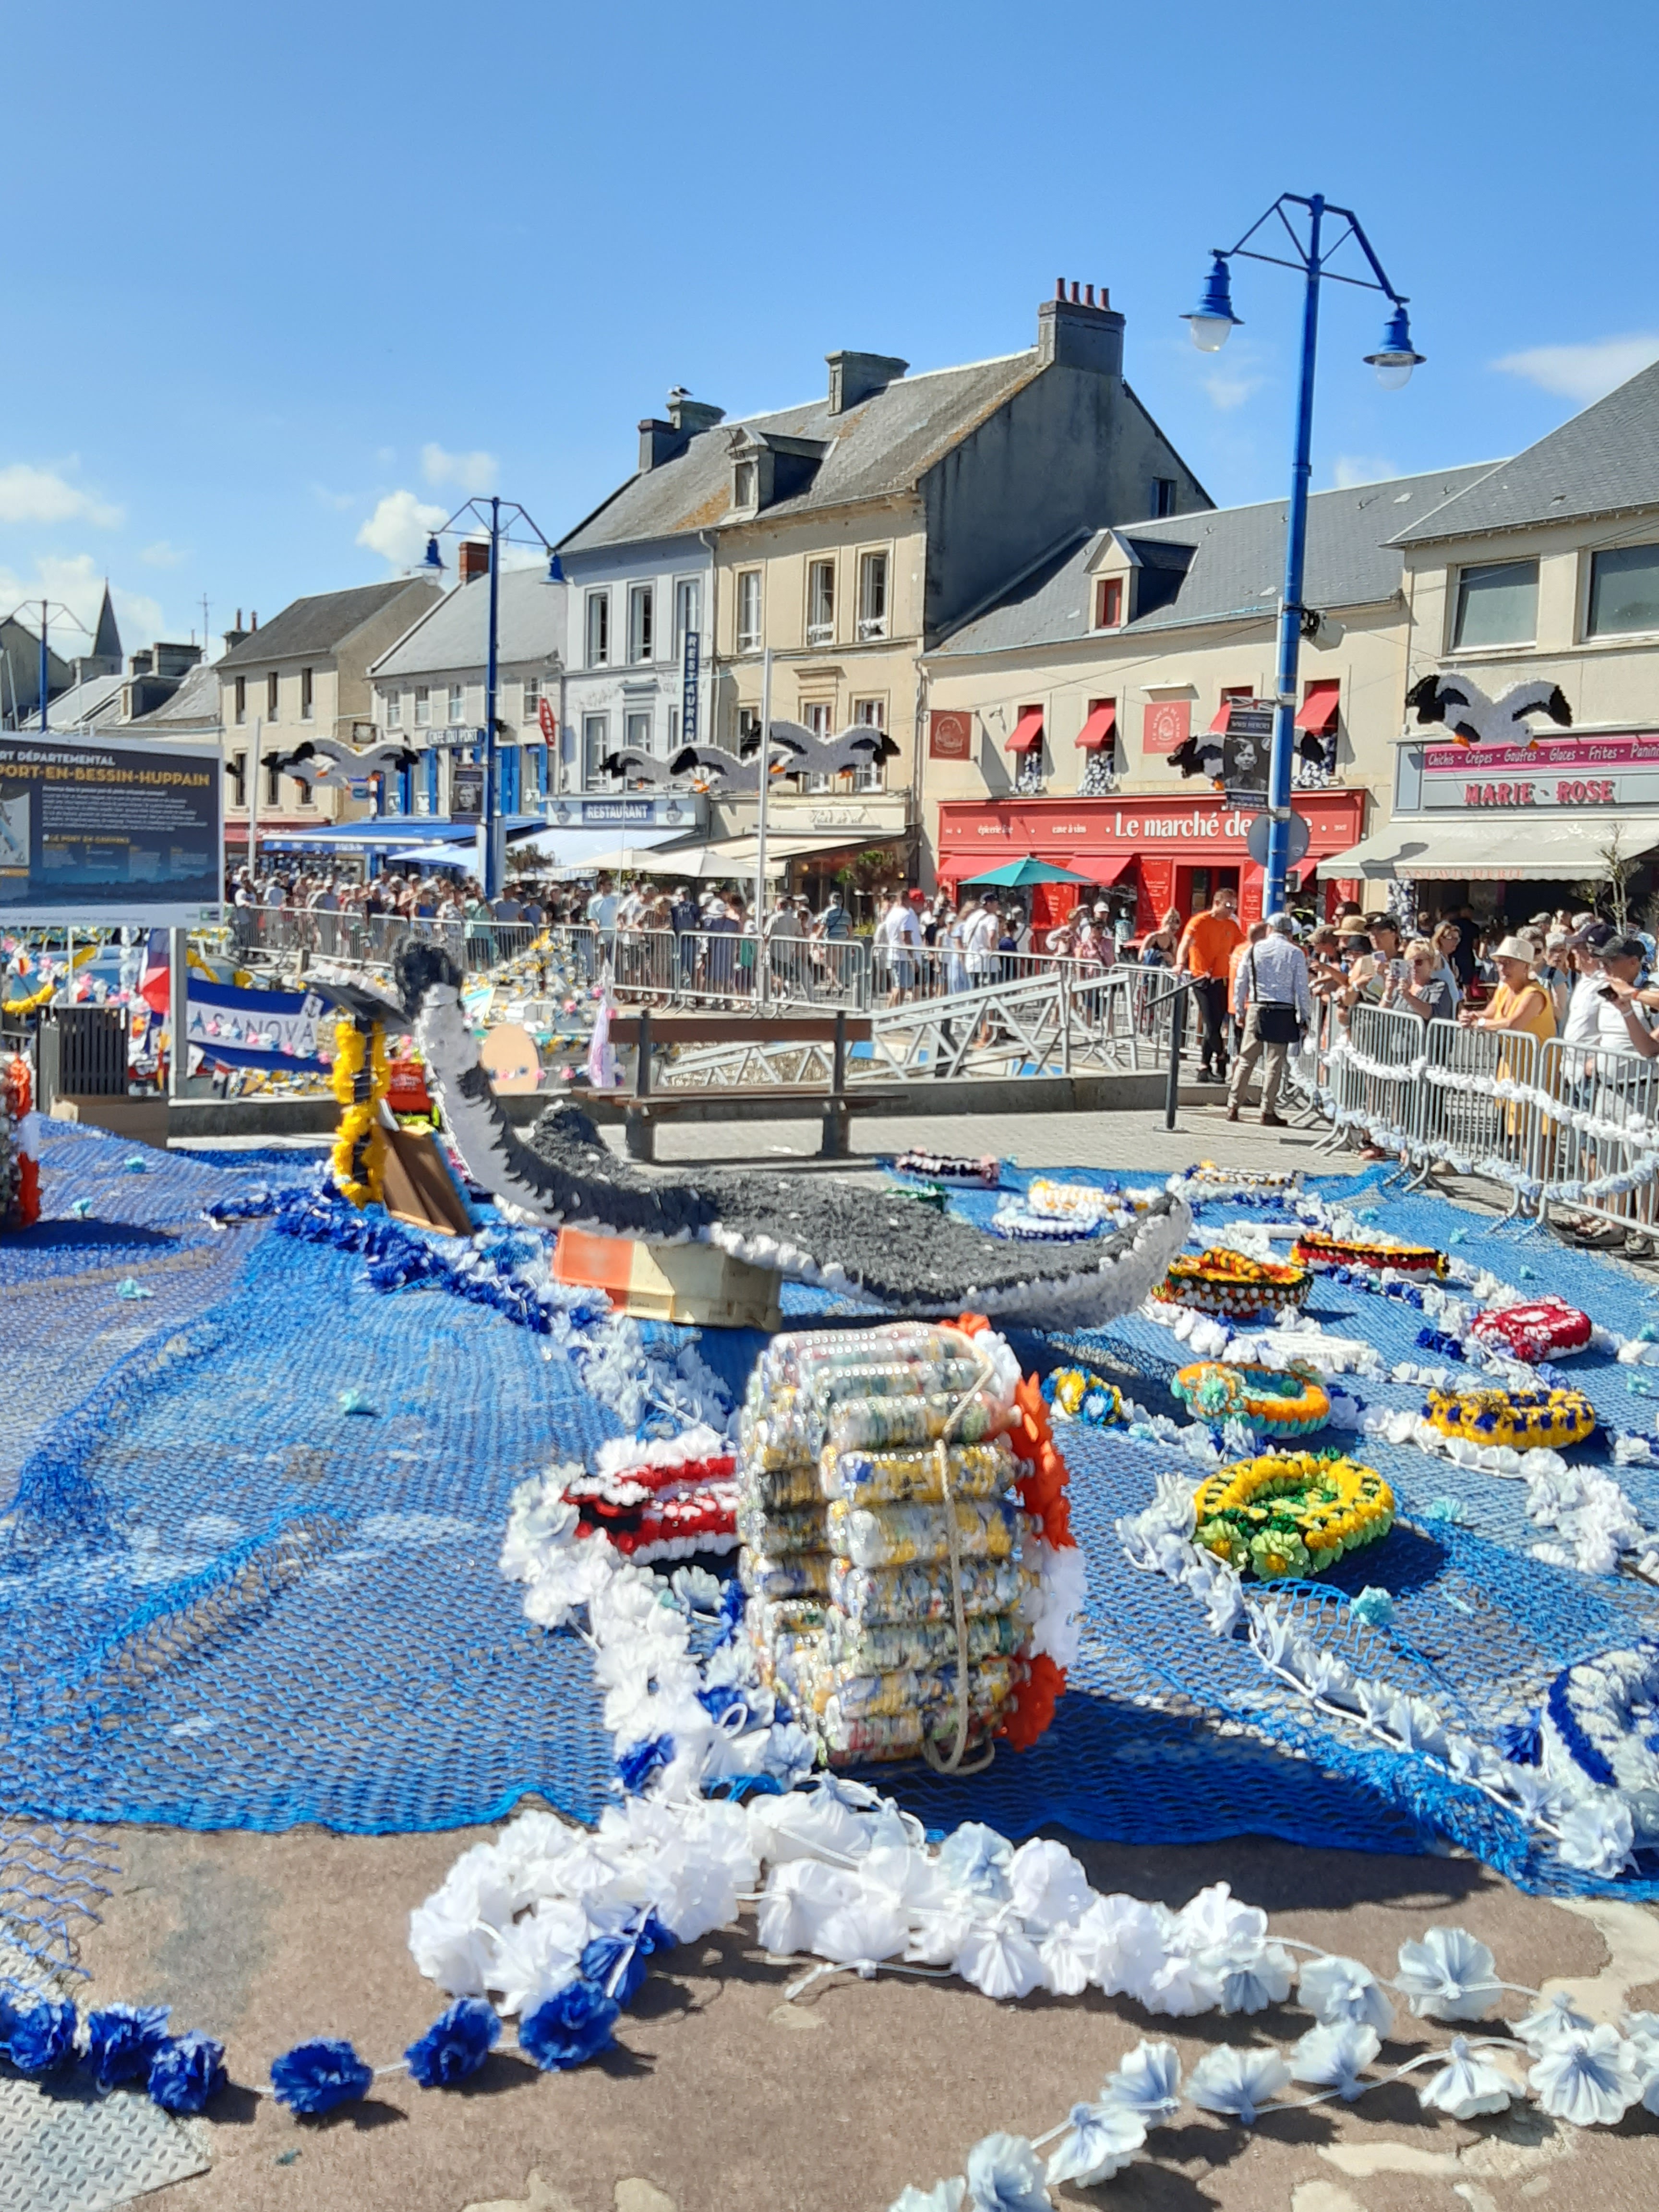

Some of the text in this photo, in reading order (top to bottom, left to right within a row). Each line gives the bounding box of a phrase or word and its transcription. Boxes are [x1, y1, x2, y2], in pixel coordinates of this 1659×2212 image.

[685, 636, 697, 742] RESTAURAN
[17, 749, 116, 766] DÉPARTEMENTAL
[1428, 753, 1454, 766] Chichis
[1465, 750, 1492, 767] Crêpes
[1503, 748, 1537, 763] Gaufres
[1549, 747, 1576, 762] Glaces
[1588, 745, 1617, 760] Frites
[1464, 782, 1533, 805] MARIE
[1555, 780, 1614, 803] ROSE
[586, 805, 648, 819] RESTAURANT
[1116, 812, 1139, 837] Le
[1144, 810, 1218, 837] marché
